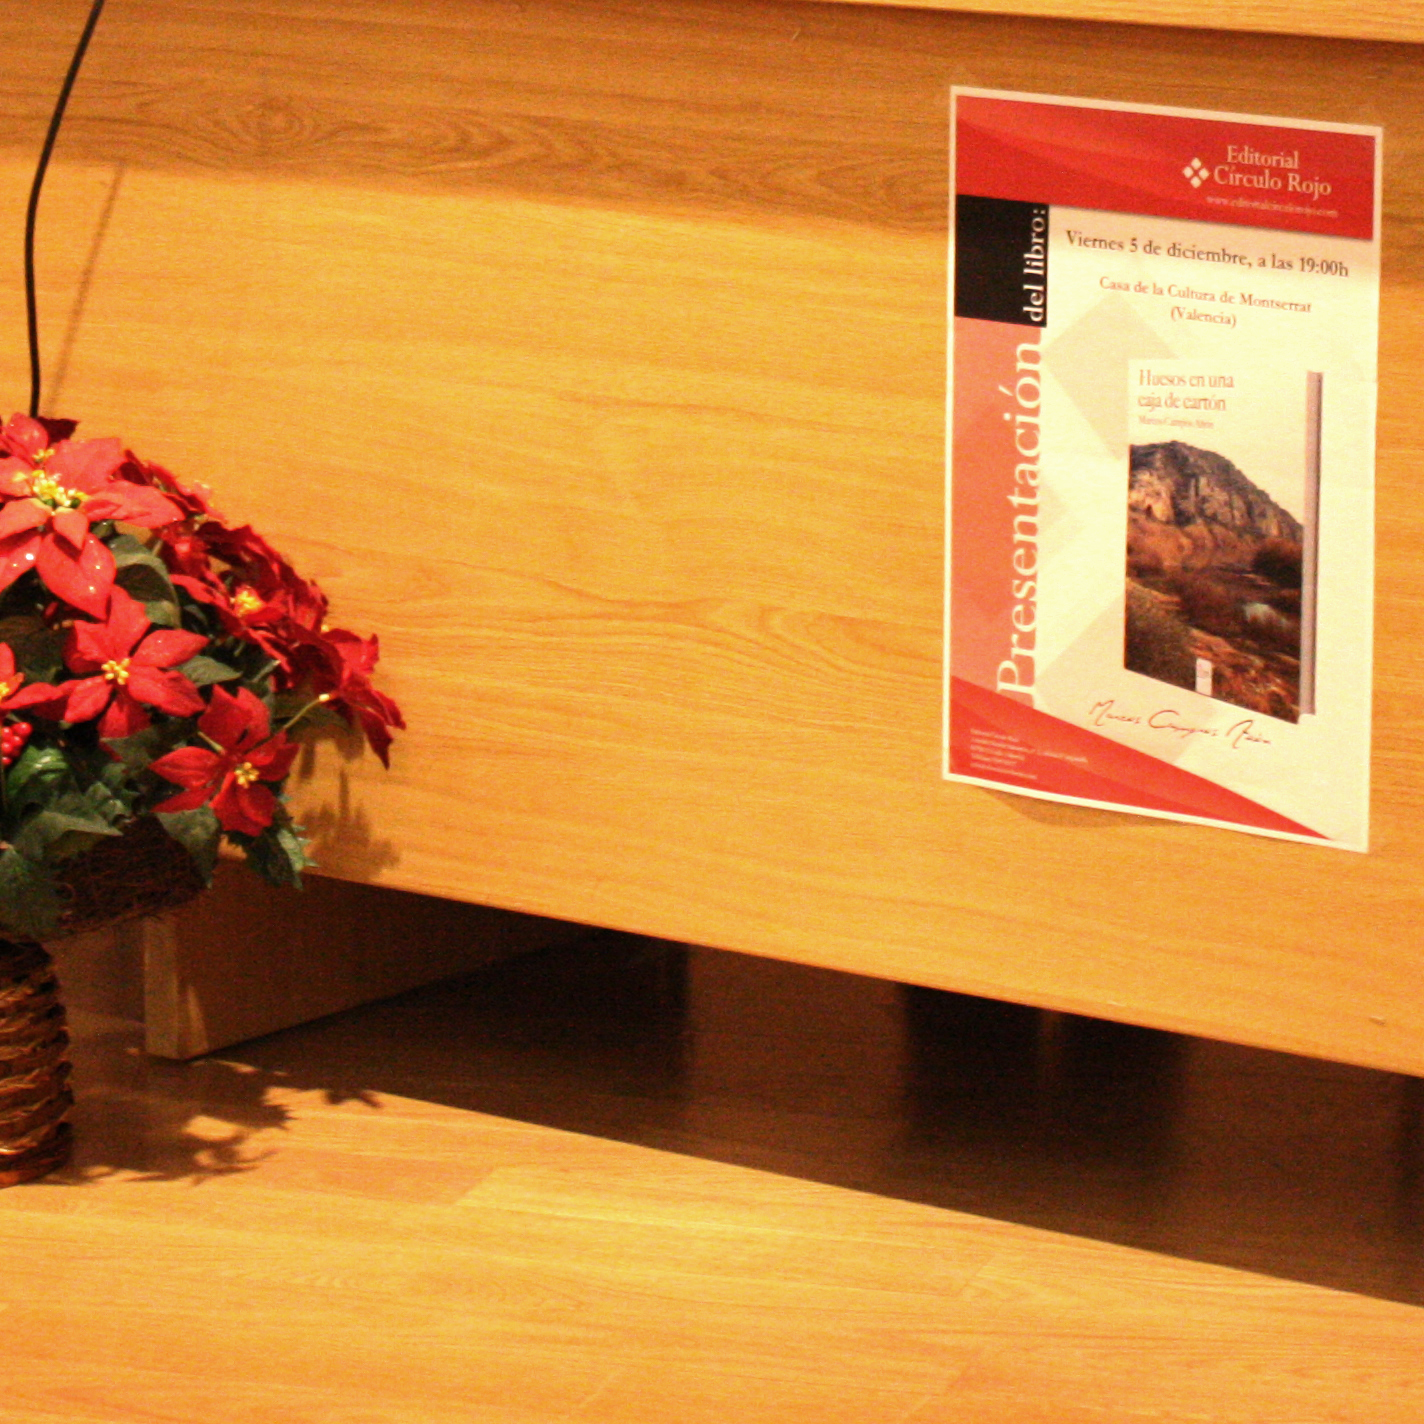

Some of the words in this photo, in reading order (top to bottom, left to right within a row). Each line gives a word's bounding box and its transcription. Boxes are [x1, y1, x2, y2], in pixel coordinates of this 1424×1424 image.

[1227, 144, 1300, 169] Editorial
[1213, 165, 1283, 190] Círculo
[1287, 172, 1333, 201] Rojo
[1023, 209, 1046, 275] libro:
[1066, 229, 1125, 251] Viernes
[1129, 237, 1138, 253] 5
[1143, 240, 1161, 255] de
[1167, 242, 1253, 268] diciembre,
[1257, 257, 1266, 268] a
[1271, 253, 1293, 270] las
[1299, 257, 1349, 277] 19:00h
[1022, 284, 1045, 322] del
[1099, 276, 1130, 292] Casa
[1133, 280, 1149, 294] de
[1153, 282, 1164, 296] la
[1168, 284, 1216, 302] Cultura
[1219, 290, 1236, 304] de
[1240, 292, 1312, 313] Montserrat
[1170, 306, 1237, 329] (Valencia)
[1139, 369, 1187, 387] Huesos
[1189, 376, 1205, 387] en
[1208, 375, 1235, 388] una
[1164, 392, 1181, 408] de
[1183, 394, 1226, 411] cartón
[996, 342, 1042, 708] Presentación
